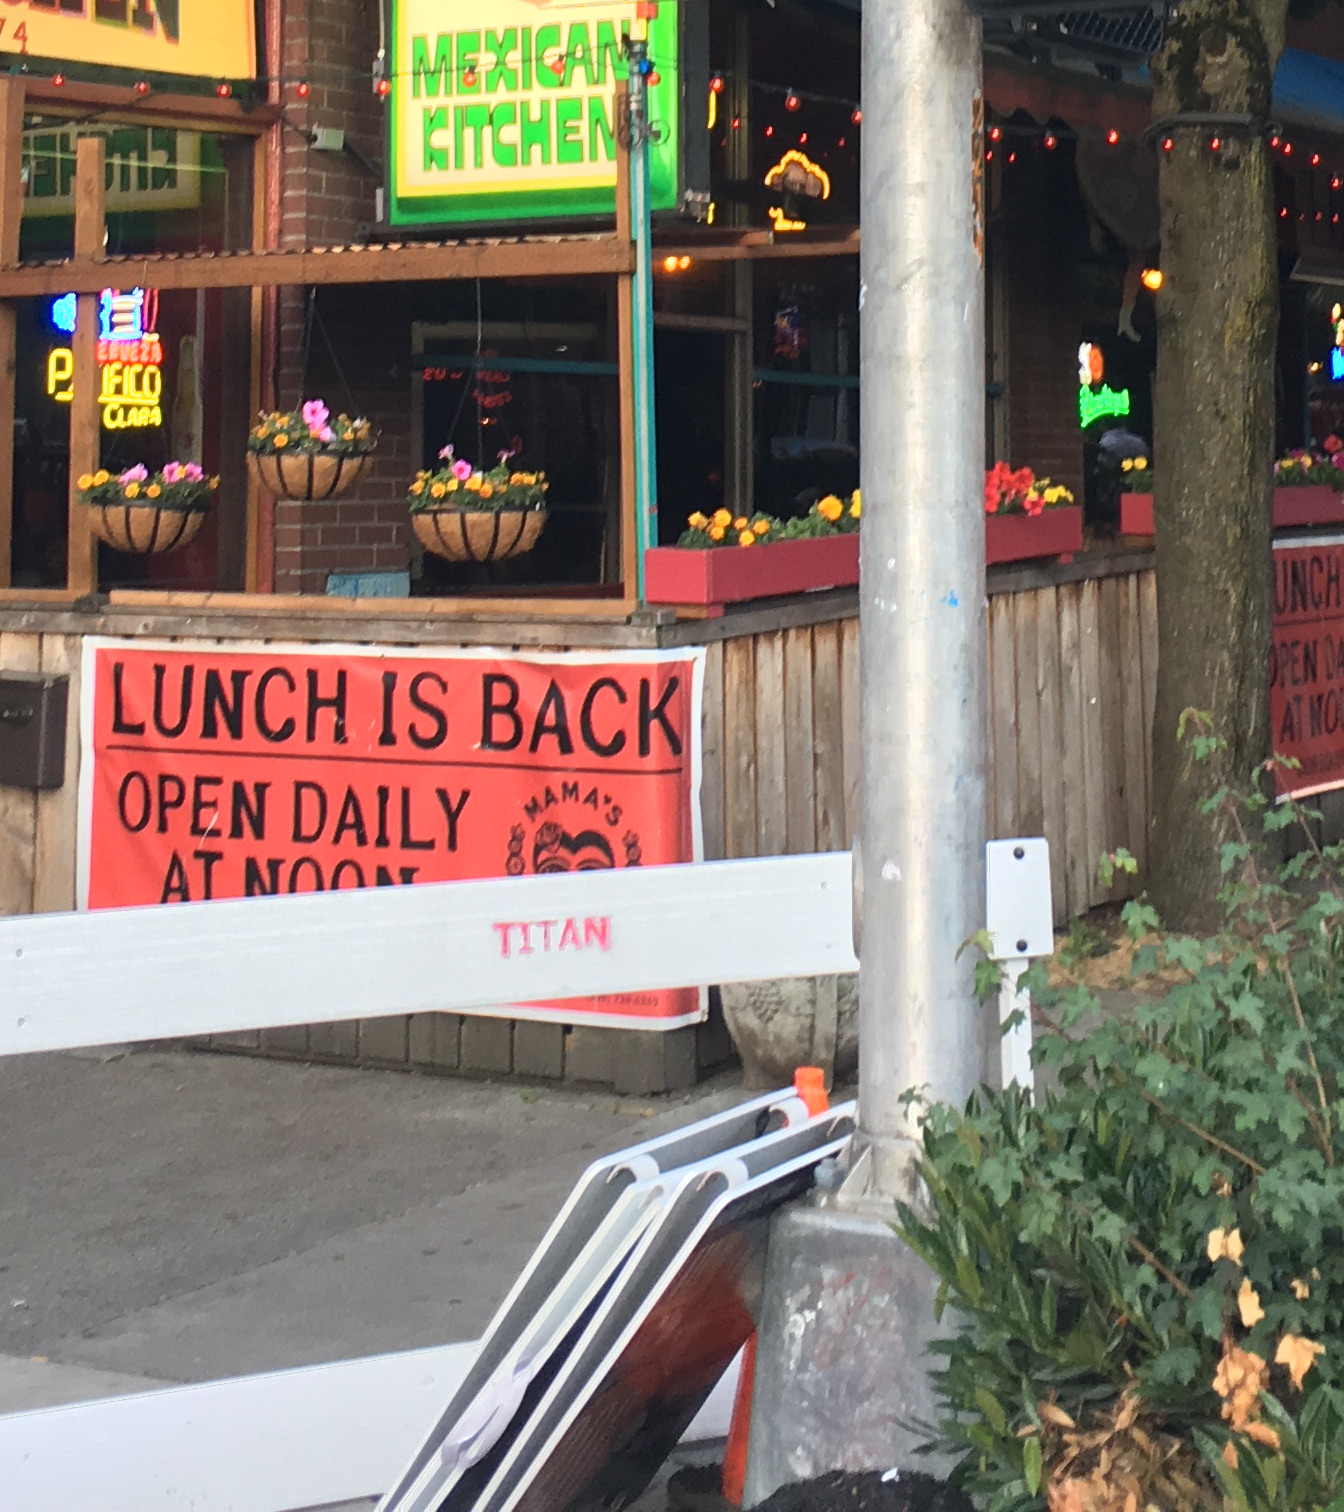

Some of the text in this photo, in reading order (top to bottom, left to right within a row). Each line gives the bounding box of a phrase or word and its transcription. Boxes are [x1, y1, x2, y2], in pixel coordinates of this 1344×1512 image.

[411, 17, 633, 99] MEXICAN
[46, 347, 163, 399] PIFICO
[96, 338, 163, 364] ERVEZA
[1274, 554, 1341, 616] UNCH
[110, 661, 684, 758] LUNCH IS BACK
[118, 770, 471, 852] OPEN DAILY
[523, 780, 623, 827] MAMA'S
[160, 849, 224, 903] AT
[492, 916, 613, 958] TITAN
